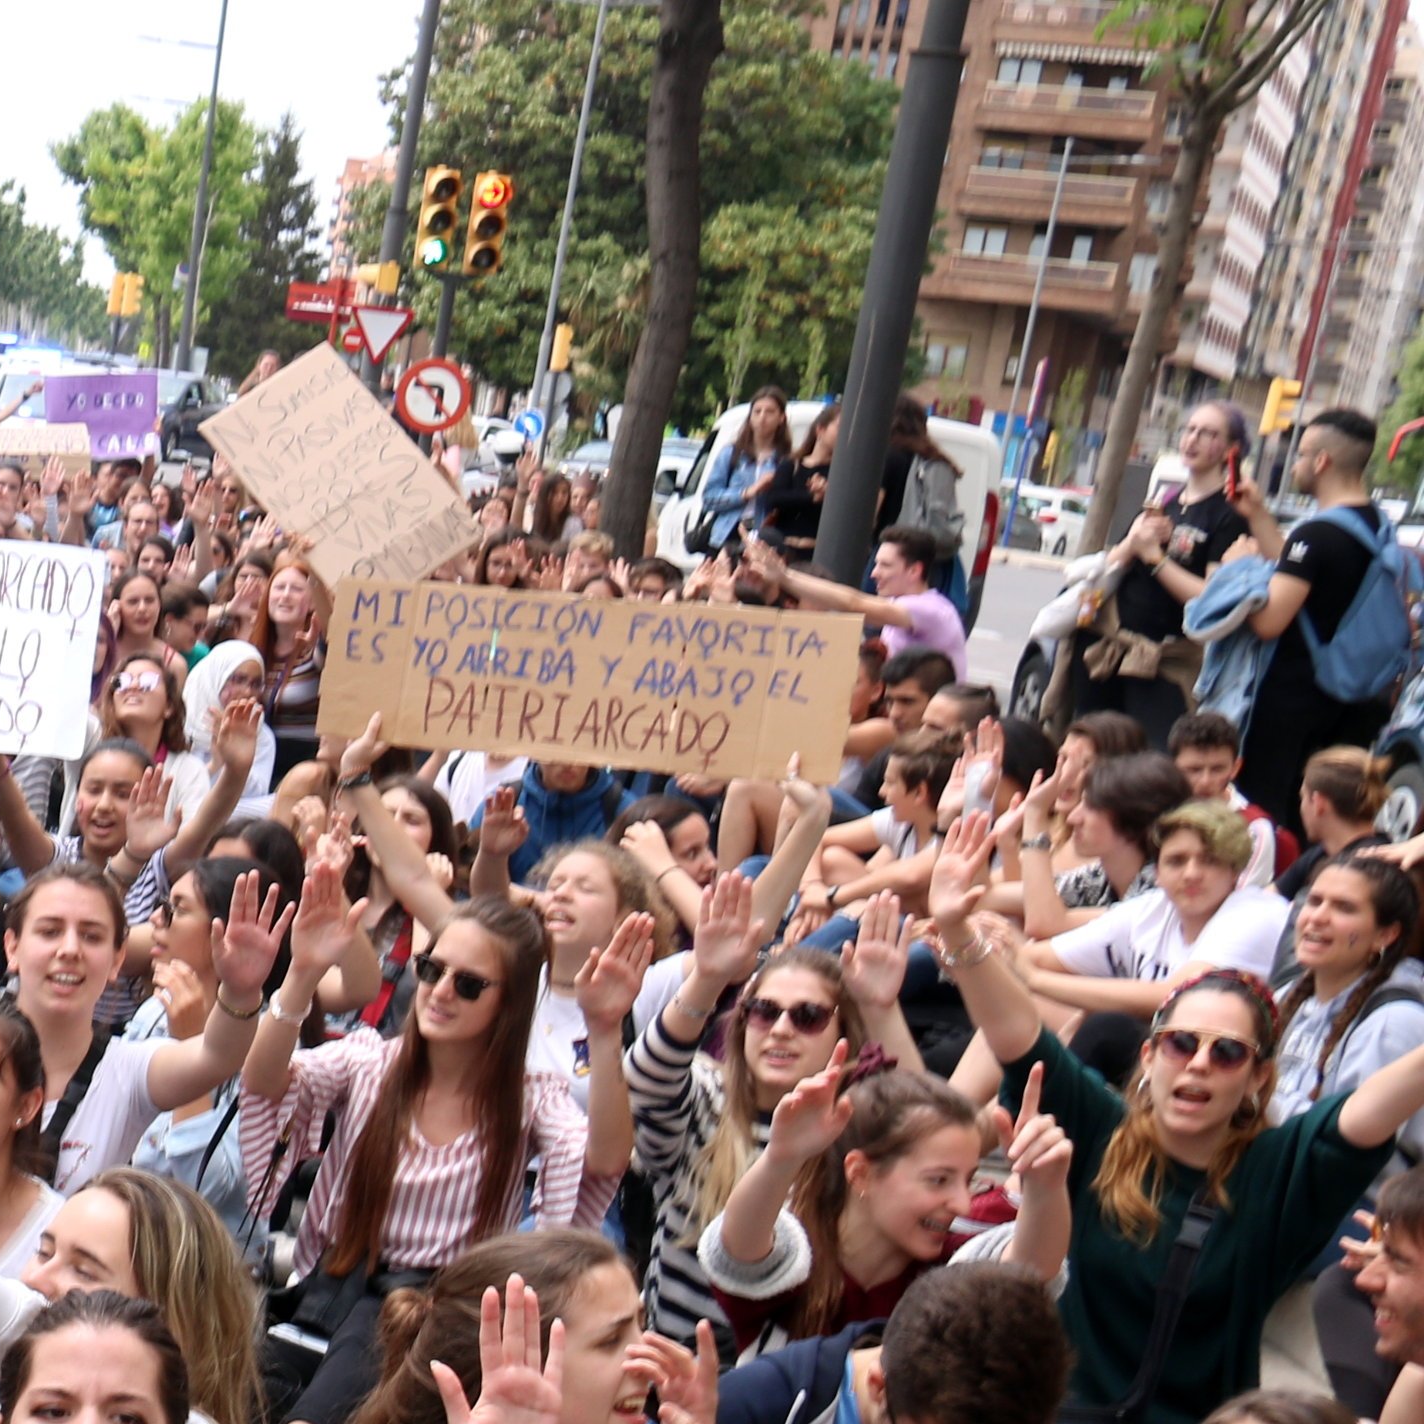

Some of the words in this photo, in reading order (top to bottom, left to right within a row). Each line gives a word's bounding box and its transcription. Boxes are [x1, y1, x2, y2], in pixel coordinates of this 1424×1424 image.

[67, 392, 86, 411] YO
[94, 392, 144, 410] DECIDO
[352, 589, 411, 627] MI
[629, 613, 828, 660] FAVORITA
[346, 629, 388, 663] ES
[414, 636, 448, 678] YO
[456, 640, 577, 687] ARRIBA
[600, 655, 622, 687] Y
[633, 657, 754, 706] ABAJO
[768, 670, 809, 704] EL
[423, 676, 730, 771] PATRIARCADO
